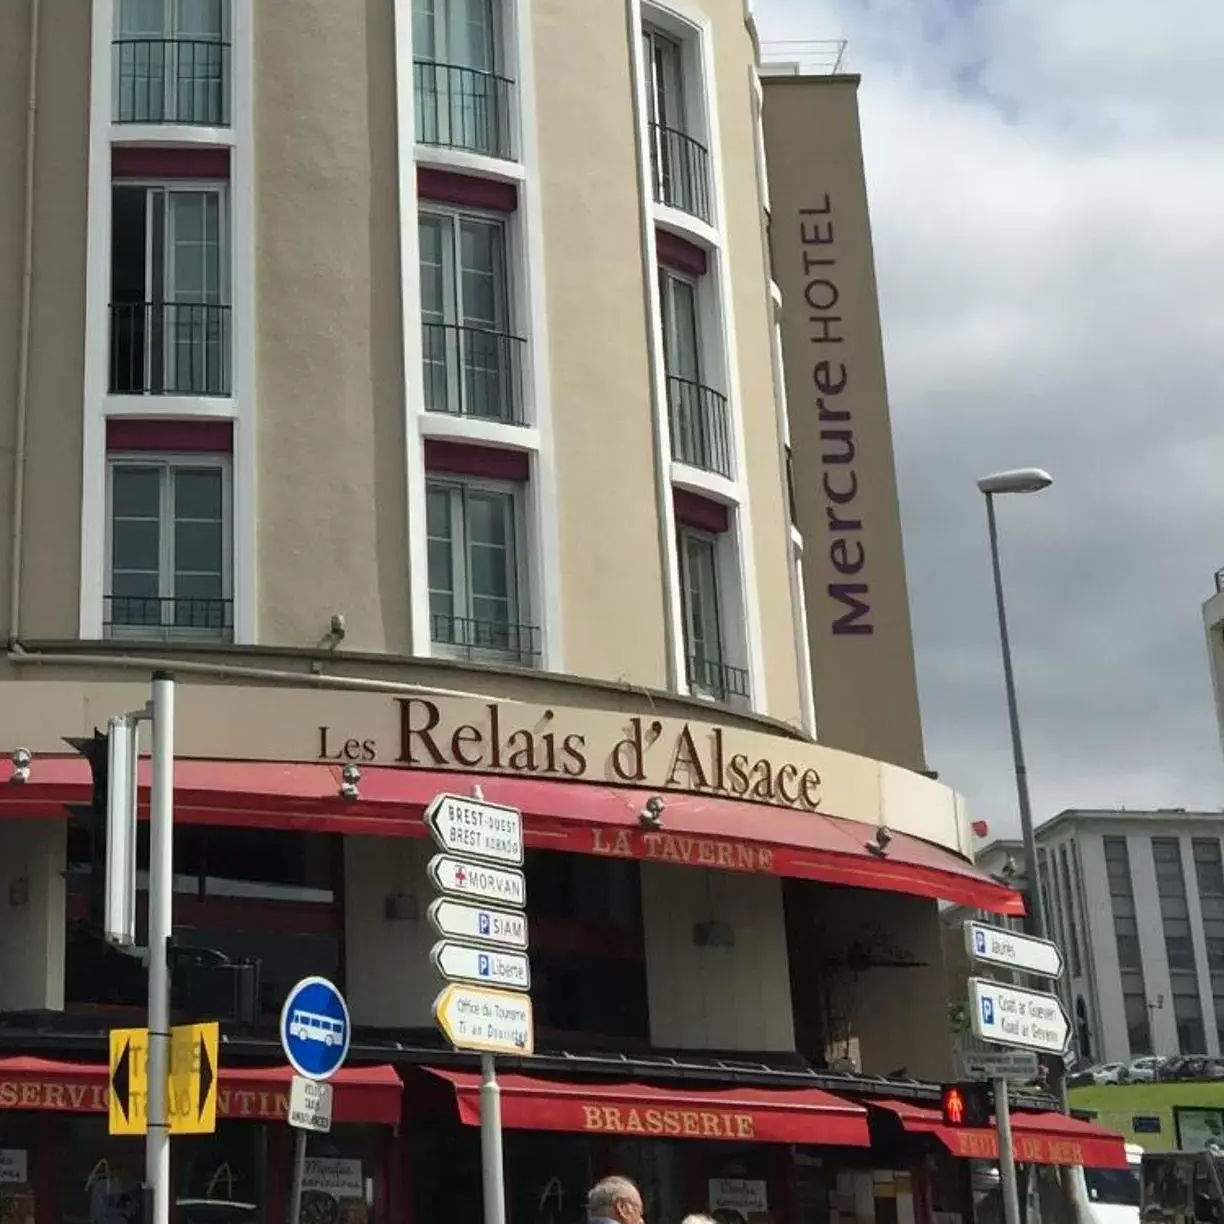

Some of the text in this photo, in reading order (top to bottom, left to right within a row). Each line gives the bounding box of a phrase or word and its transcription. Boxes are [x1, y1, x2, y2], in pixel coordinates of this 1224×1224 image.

[798, 193, 874, 635] Mercure HOTEL
[318, 697, 822, 808] Les Relais d'Alsace
[450, 826, 481, 847] BREST
[591, 828, 775, 871] LA TAVERNE
[468, 871, 520, 897] MORVAN
[493, 918, 523, 936] SIAM
[582, 1105, 755, 1139] BRASSERIE
